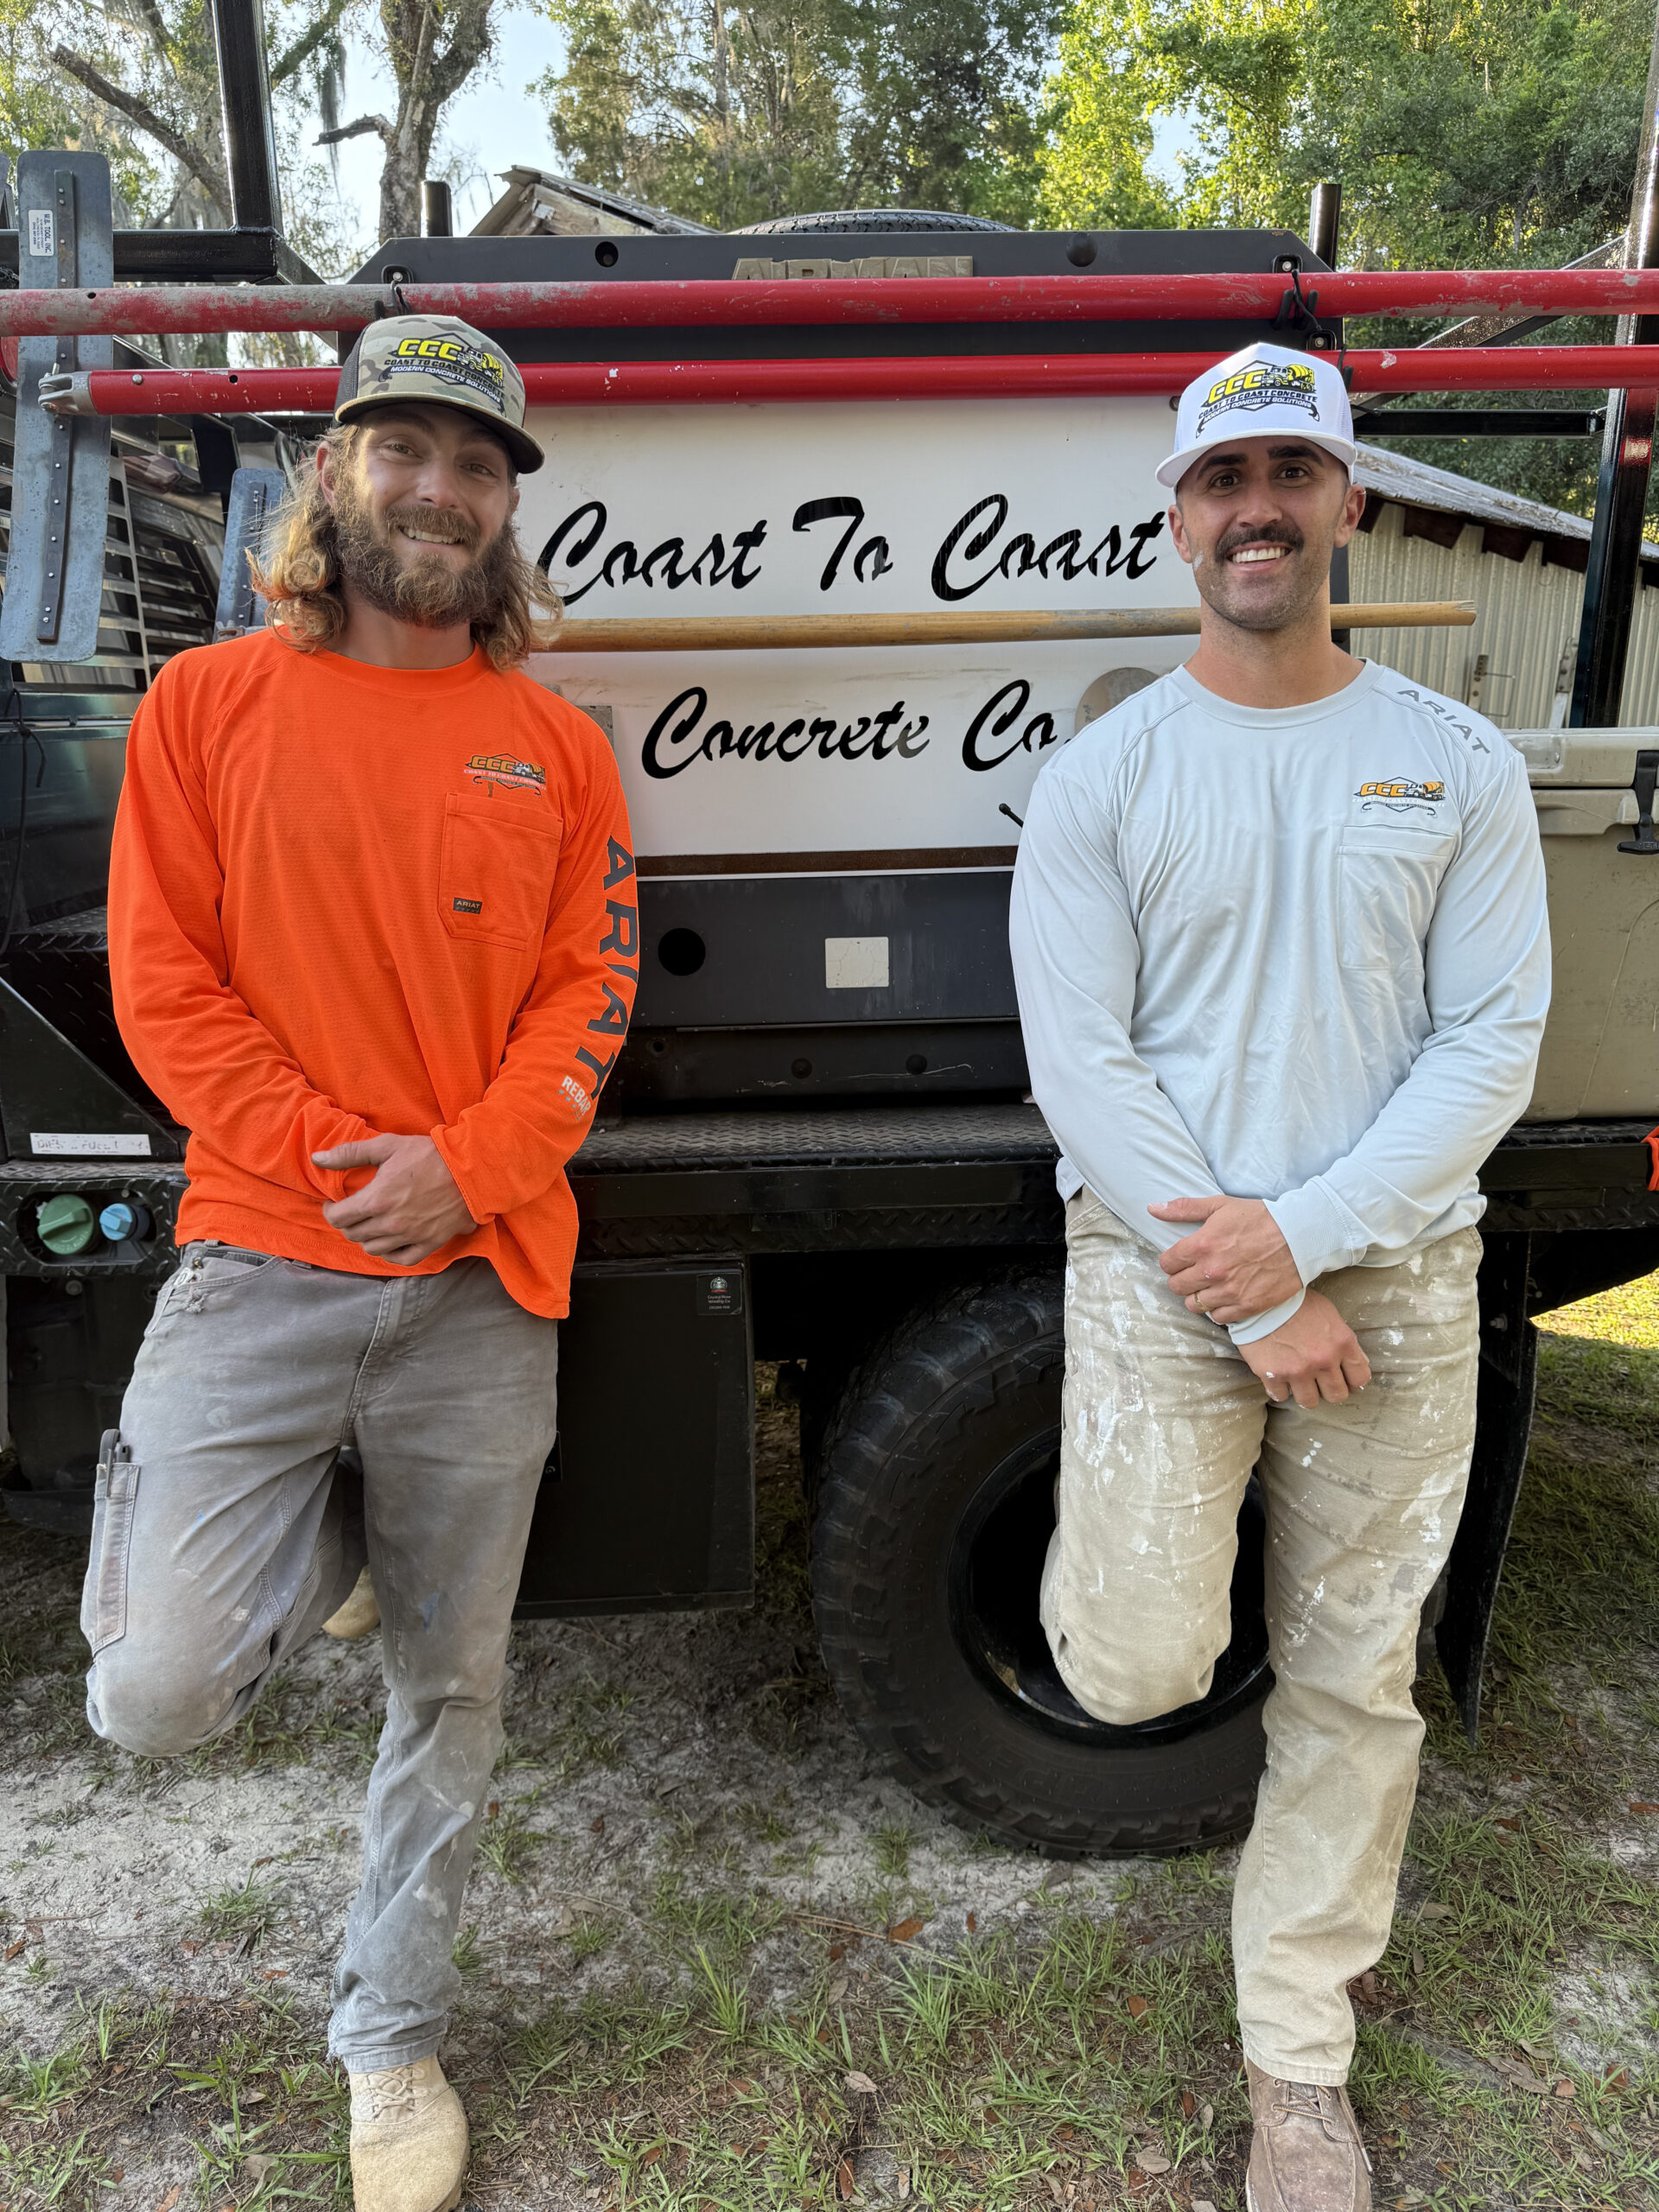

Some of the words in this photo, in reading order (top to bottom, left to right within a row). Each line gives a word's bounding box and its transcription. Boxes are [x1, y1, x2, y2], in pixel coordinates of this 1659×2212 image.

[397, 339, 462, 361] CCC
[425, 366, 466, 382] CONCRETE
[465, 378, 501, 403] SOLUTIONS
[432, 360, 466, 376] COAST
[465, 370, 505, 398] CONCRETE
[1208, 370, 1267, 404] CCC
[1198, 402, 1224, 420] COAST
[1224, 396, 1236, 404] TO
[1237, 390, 1269, 401] COAST
[1270, 389, 1319, 403] CONCRETE
[1203, 404, 1231, 423] MODERN
[1231, 397, 1271, 409] CONCRETE
[1271, 397, 1313, 409] SOLUTIONS
[533, 501, 767, 607] Coast
[792, 496, 893, 591] To
[931, 493, 1166, 601] Coast
[641, 686, 931, 779] Concrete
[1397, 690, 1491, 754] ARIAT
[471, 755, 516, 773] CCC
[1360, 782, 1408, 797] CCC
[456, 900, 480, 909] ARIAT
[575, 835, 639, 1100] ARIAT
[562, 1075, 593, 1116] REBAR
